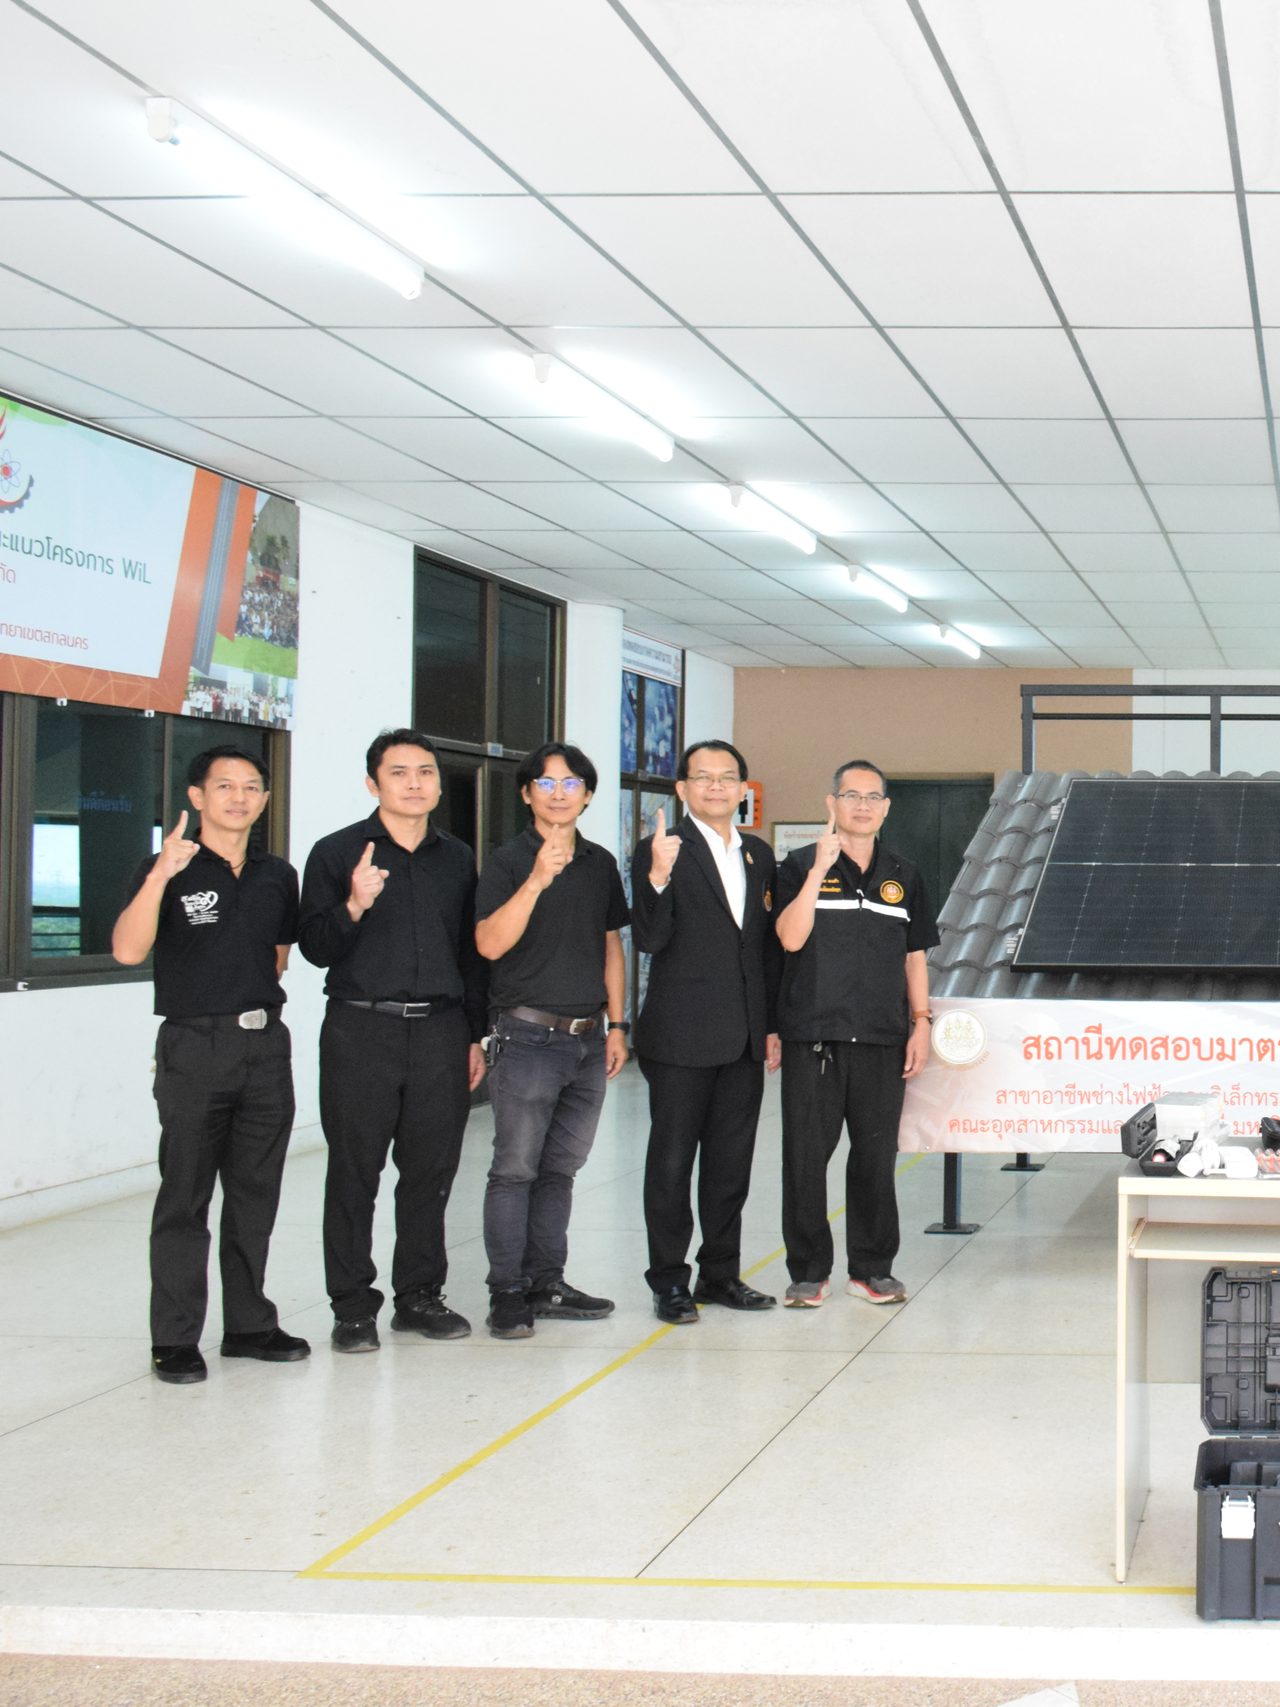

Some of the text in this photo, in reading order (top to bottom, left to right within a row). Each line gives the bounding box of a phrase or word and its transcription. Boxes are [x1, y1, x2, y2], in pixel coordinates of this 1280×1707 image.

[0, 531, 152, 585] ะแนวโครงการ WiL
